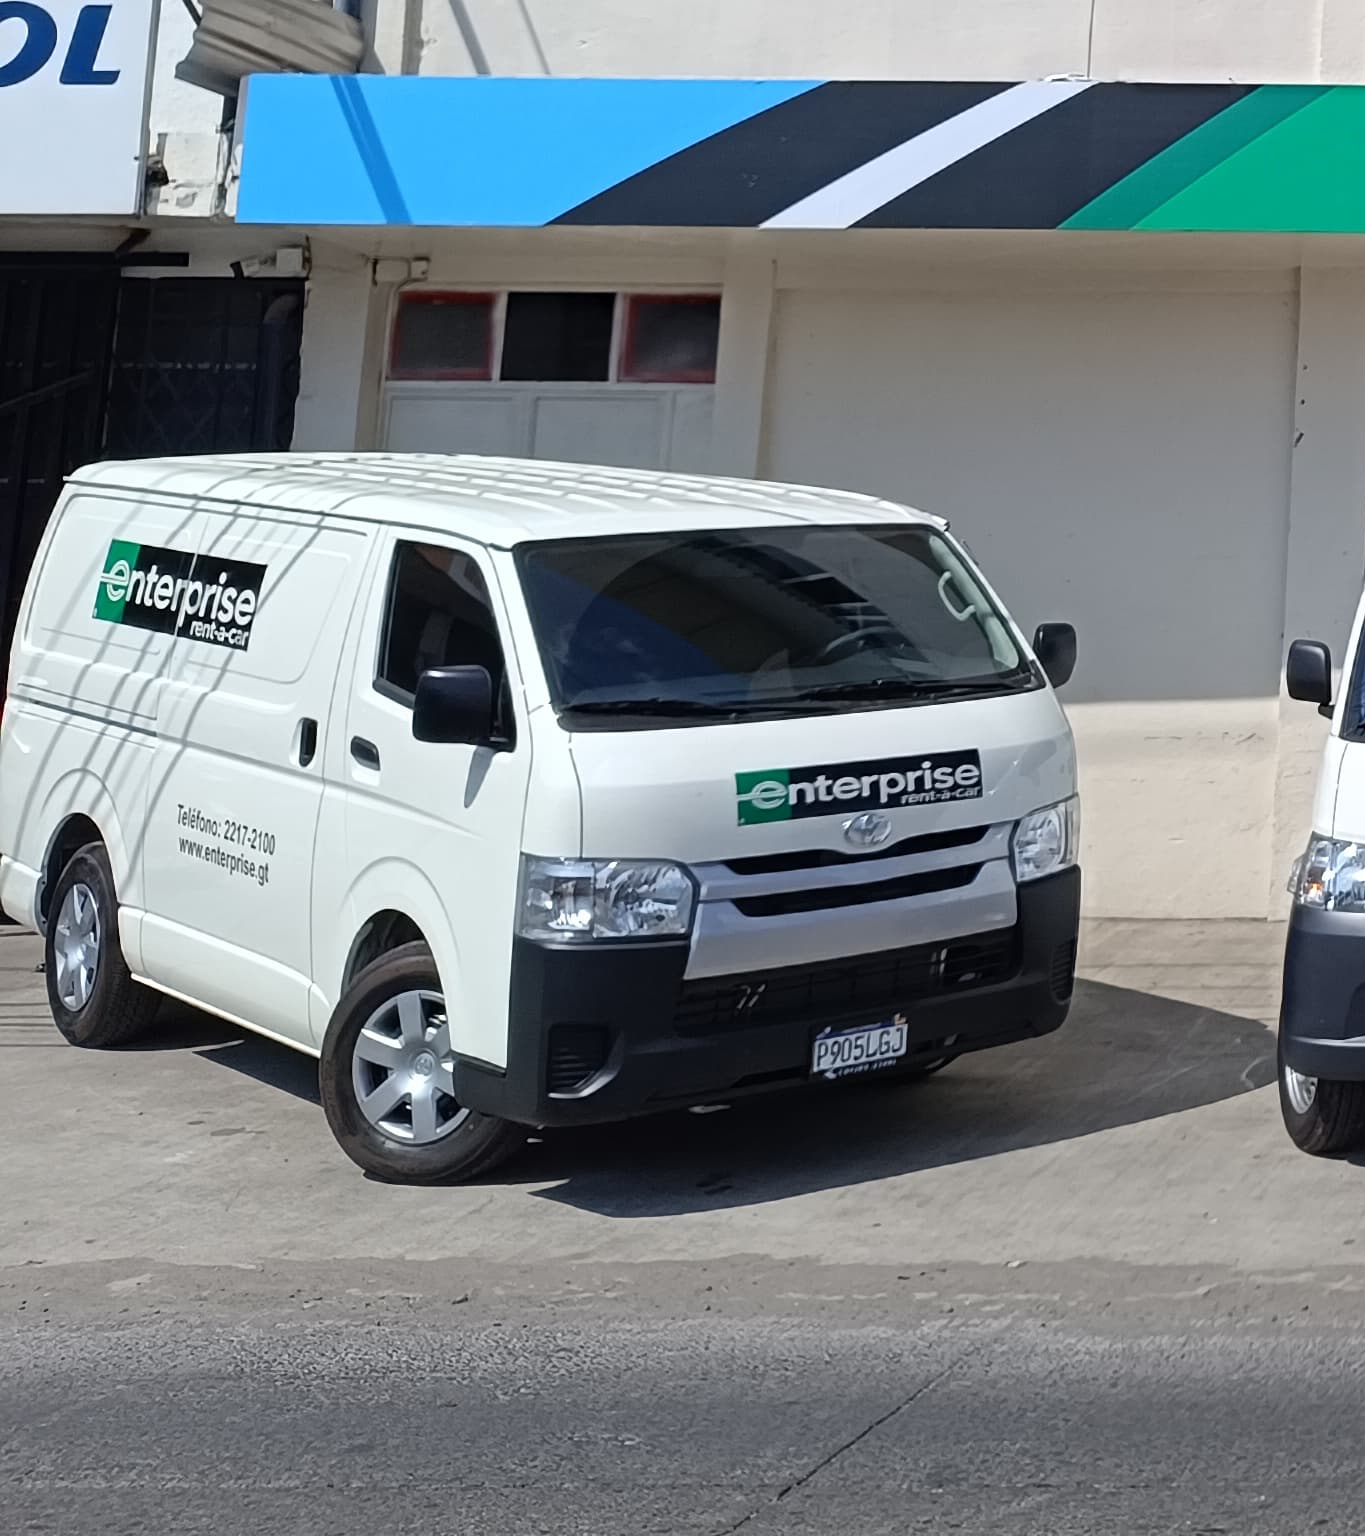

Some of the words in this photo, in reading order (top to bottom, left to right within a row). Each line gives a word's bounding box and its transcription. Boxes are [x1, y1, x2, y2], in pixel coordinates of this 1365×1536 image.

[101, 559, 256, 627] enterprise
[190, 621, 249, 647] rent-a-car
[737, 761, 981, 809] enterprise
[901, 785, 981, 805] rent-a-car
[178, 803, 221, 838] Teléfono:
[224, 819, 276, 855] 2217-2100
[179, 836, 269, 887] www.enterprise.gt
[817, 1027, 904, 1068] P905LGJ
